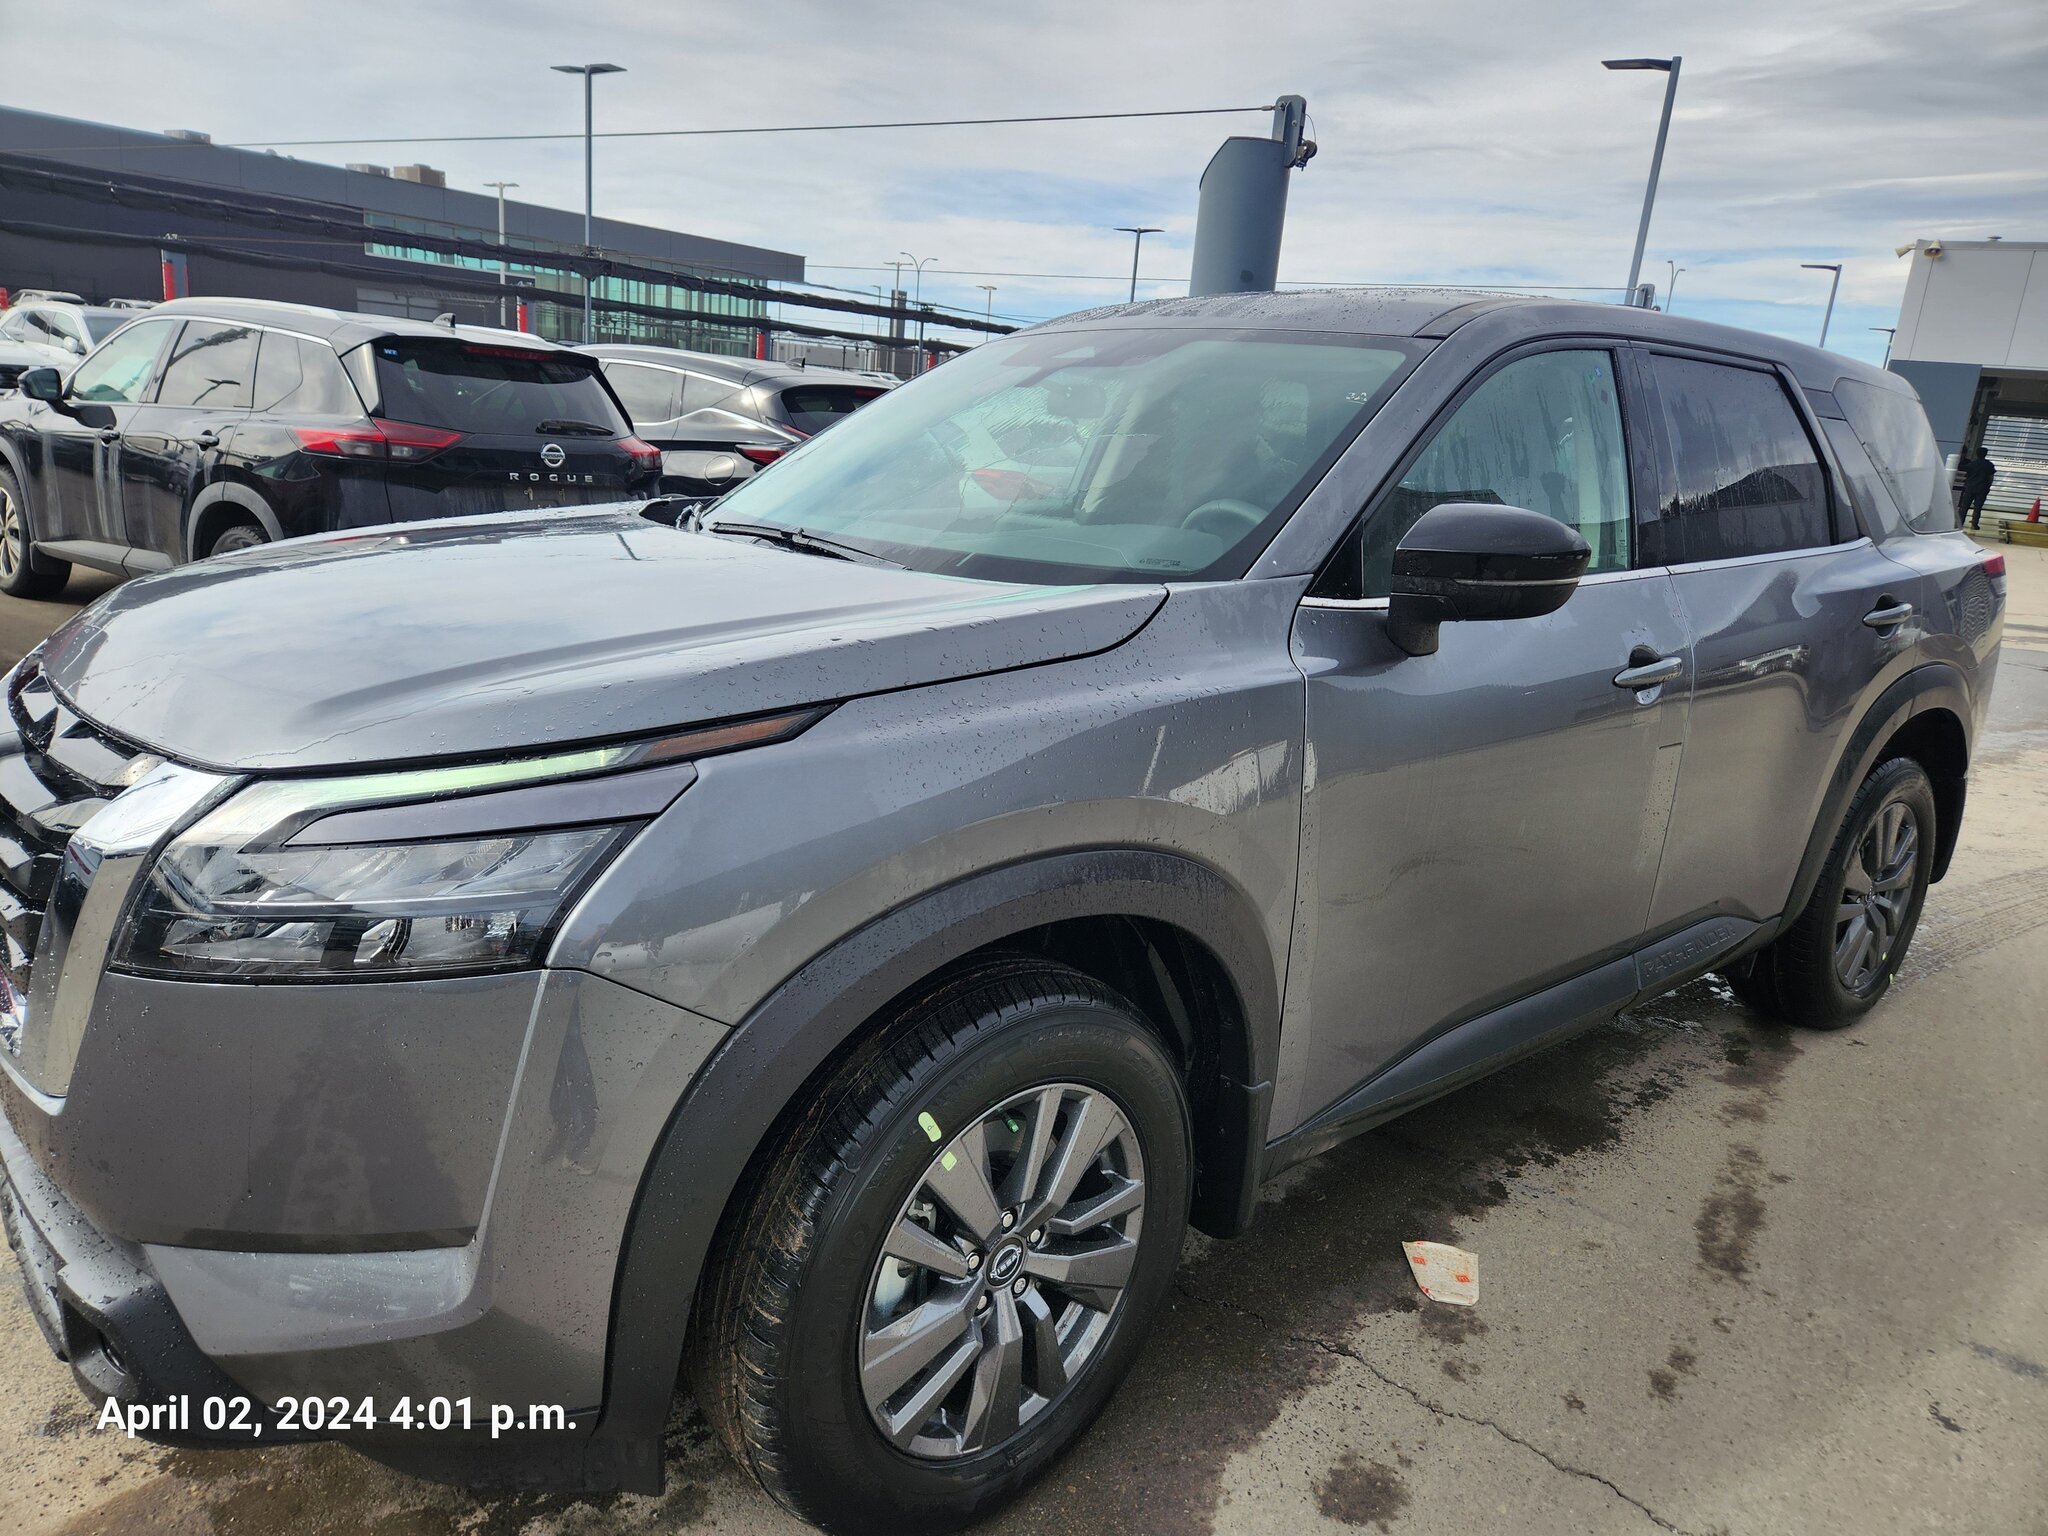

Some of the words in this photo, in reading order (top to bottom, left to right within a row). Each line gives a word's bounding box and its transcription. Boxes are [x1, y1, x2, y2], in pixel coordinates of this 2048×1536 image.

[509, 472, 593, 483] ROGUE
[1643, 924, 1736, 977] PATHFINDER
[990, 1245, 1022, 1279] NISSAN
